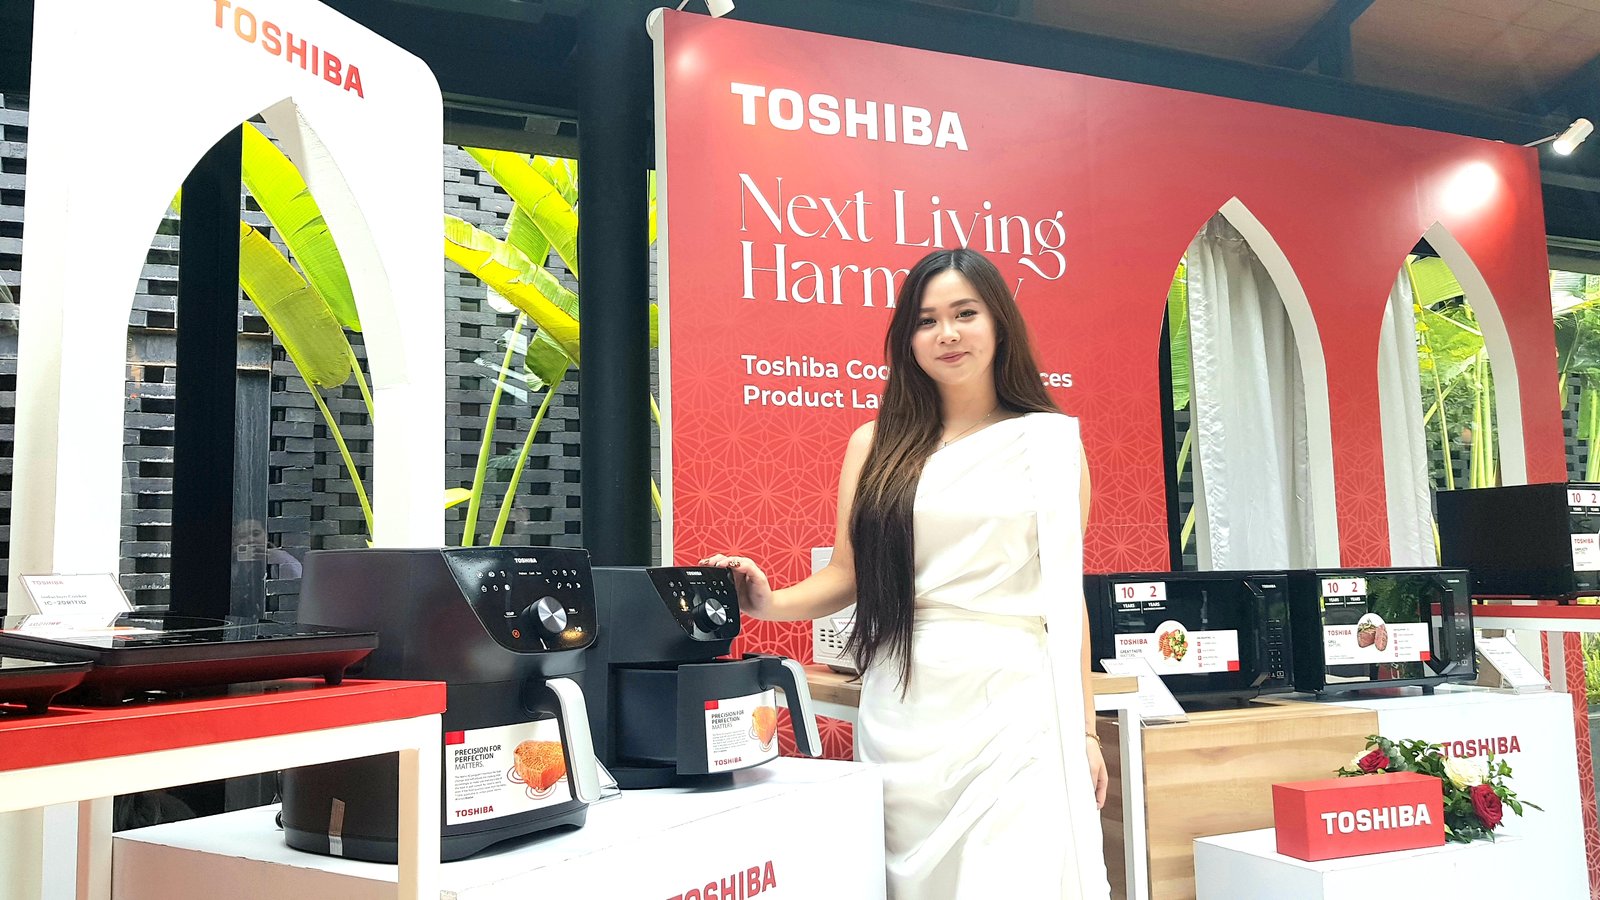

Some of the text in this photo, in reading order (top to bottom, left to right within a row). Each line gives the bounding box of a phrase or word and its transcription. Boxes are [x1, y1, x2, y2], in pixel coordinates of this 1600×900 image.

[213, 0, 364, 99] TOSHIBA
[730, 82, 968, 151] TOSHIBA
[738, 173, 1067, 280] Next Living
[740, 240, 1024, 309] Harm
[740, 354, 839, 379] Toshiba
[743, 385, 845, 408] Product
[1571, 492, 1597, 504] 10 2
[1121, 585, 1157, 599] 10 2
[1327, 581, 1358, 593] 10 2
[454, 744, 502, 757] PRECISION FOR
[454, 752, 494, 763] PERFECTION
[1441, 735, 1521, 760] TOSHIBA
[454, 761, 485, 771] MATTERS.
[714, 756, 742, 766] TOSHIBA
[455, 805, 494, 818] TOSHIBA
[1320, 803, 1432, 835] TOSHIBA
[665, 860, 777, 900] SHIBA
